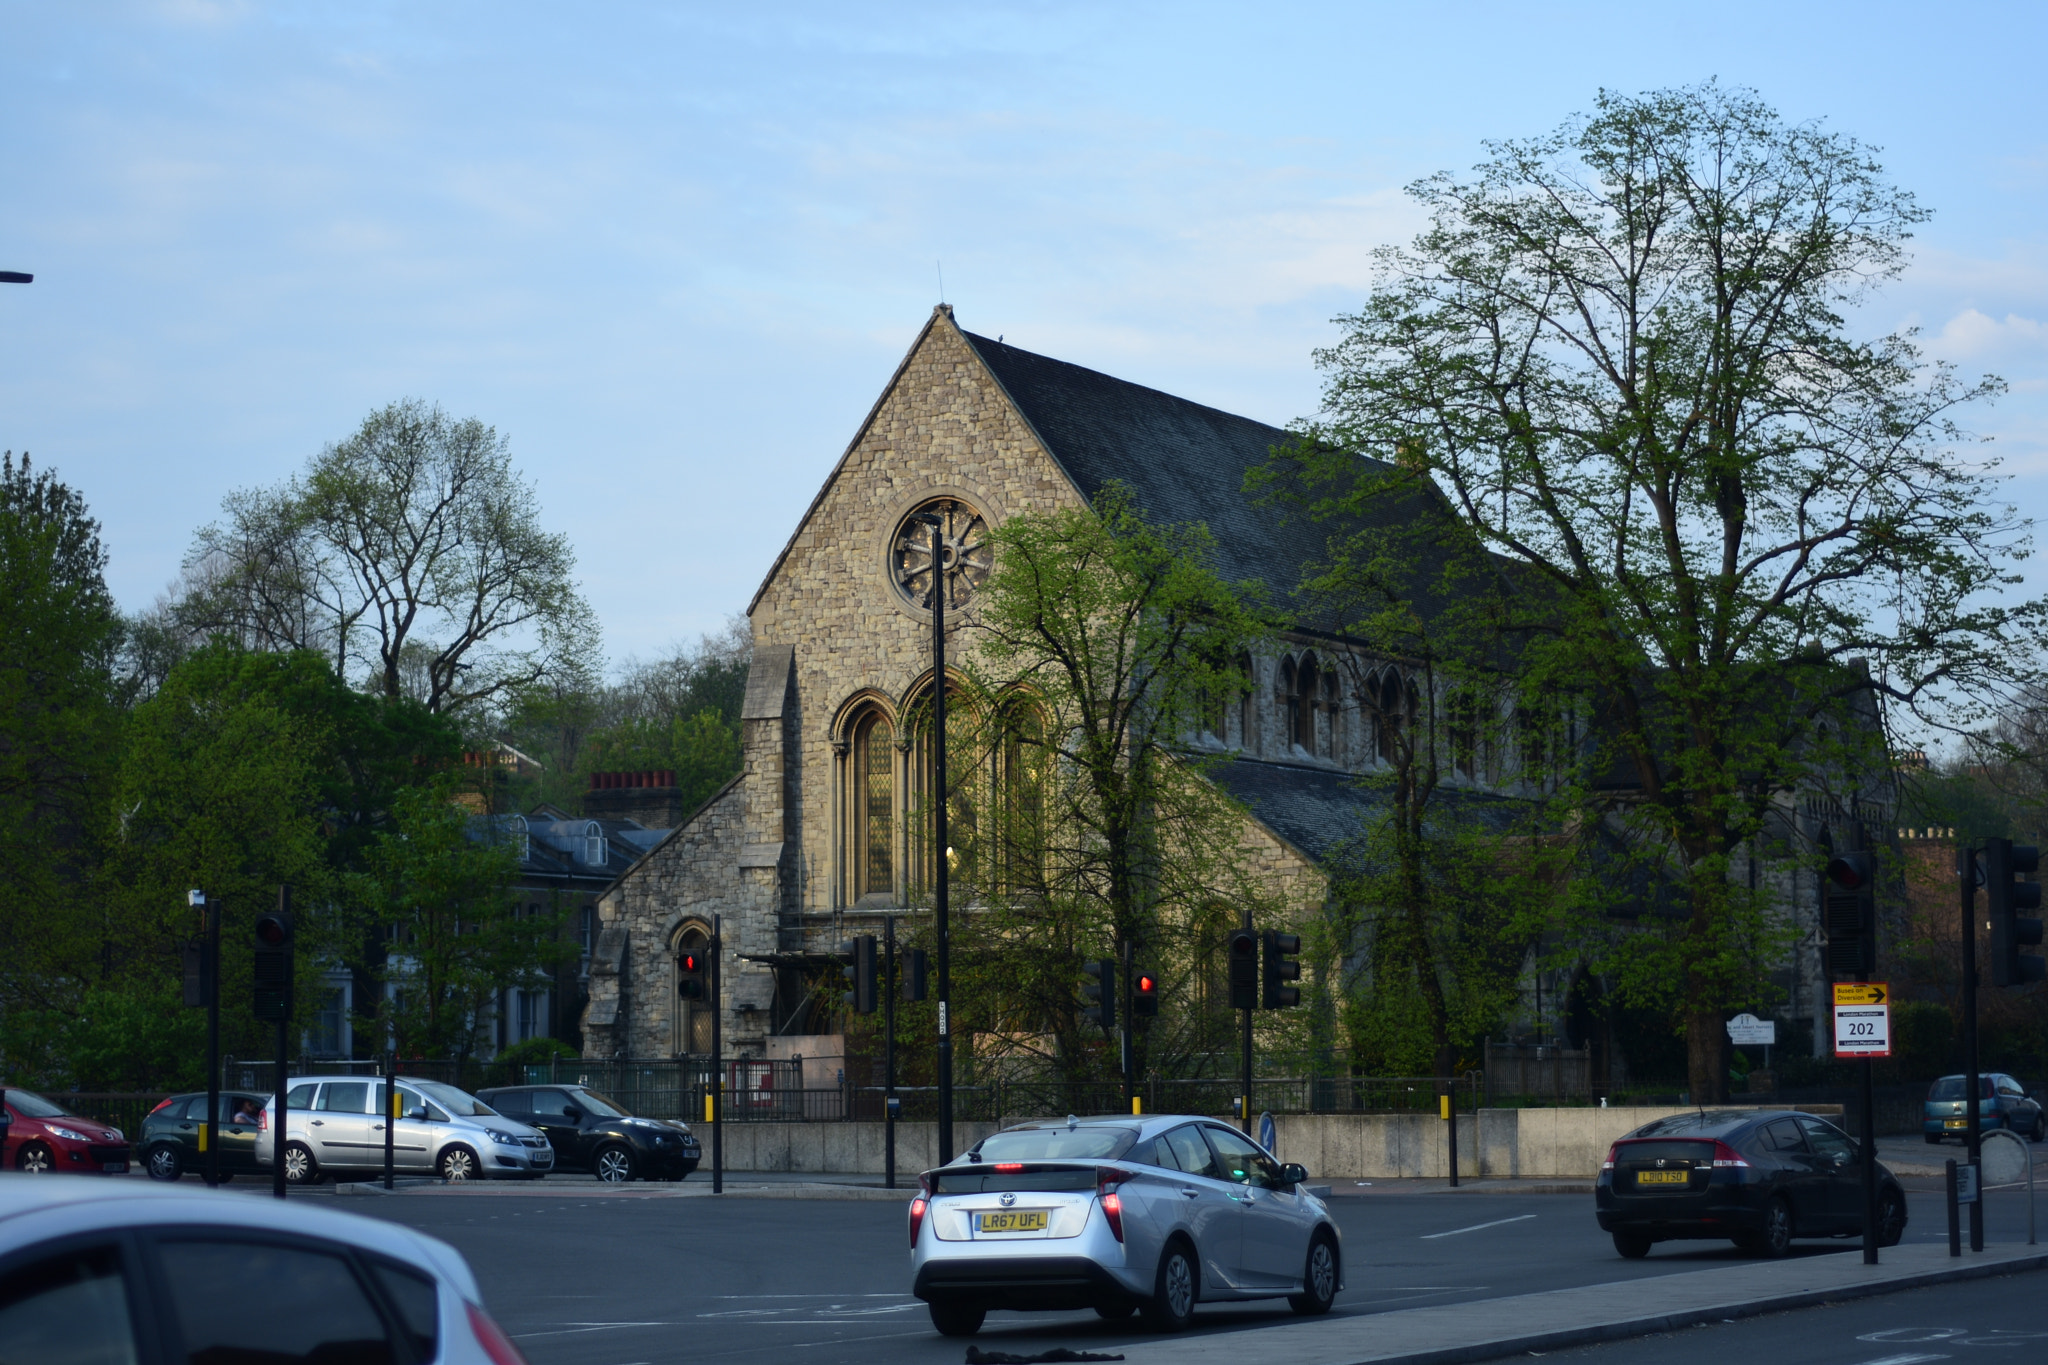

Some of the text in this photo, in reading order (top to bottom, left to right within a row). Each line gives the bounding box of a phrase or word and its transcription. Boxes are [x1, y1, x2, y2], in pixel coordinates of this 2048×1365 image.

[1848, 1022, 1874, 1035] 202
[982, 1213, 1045, 1228] LR67 UFL
